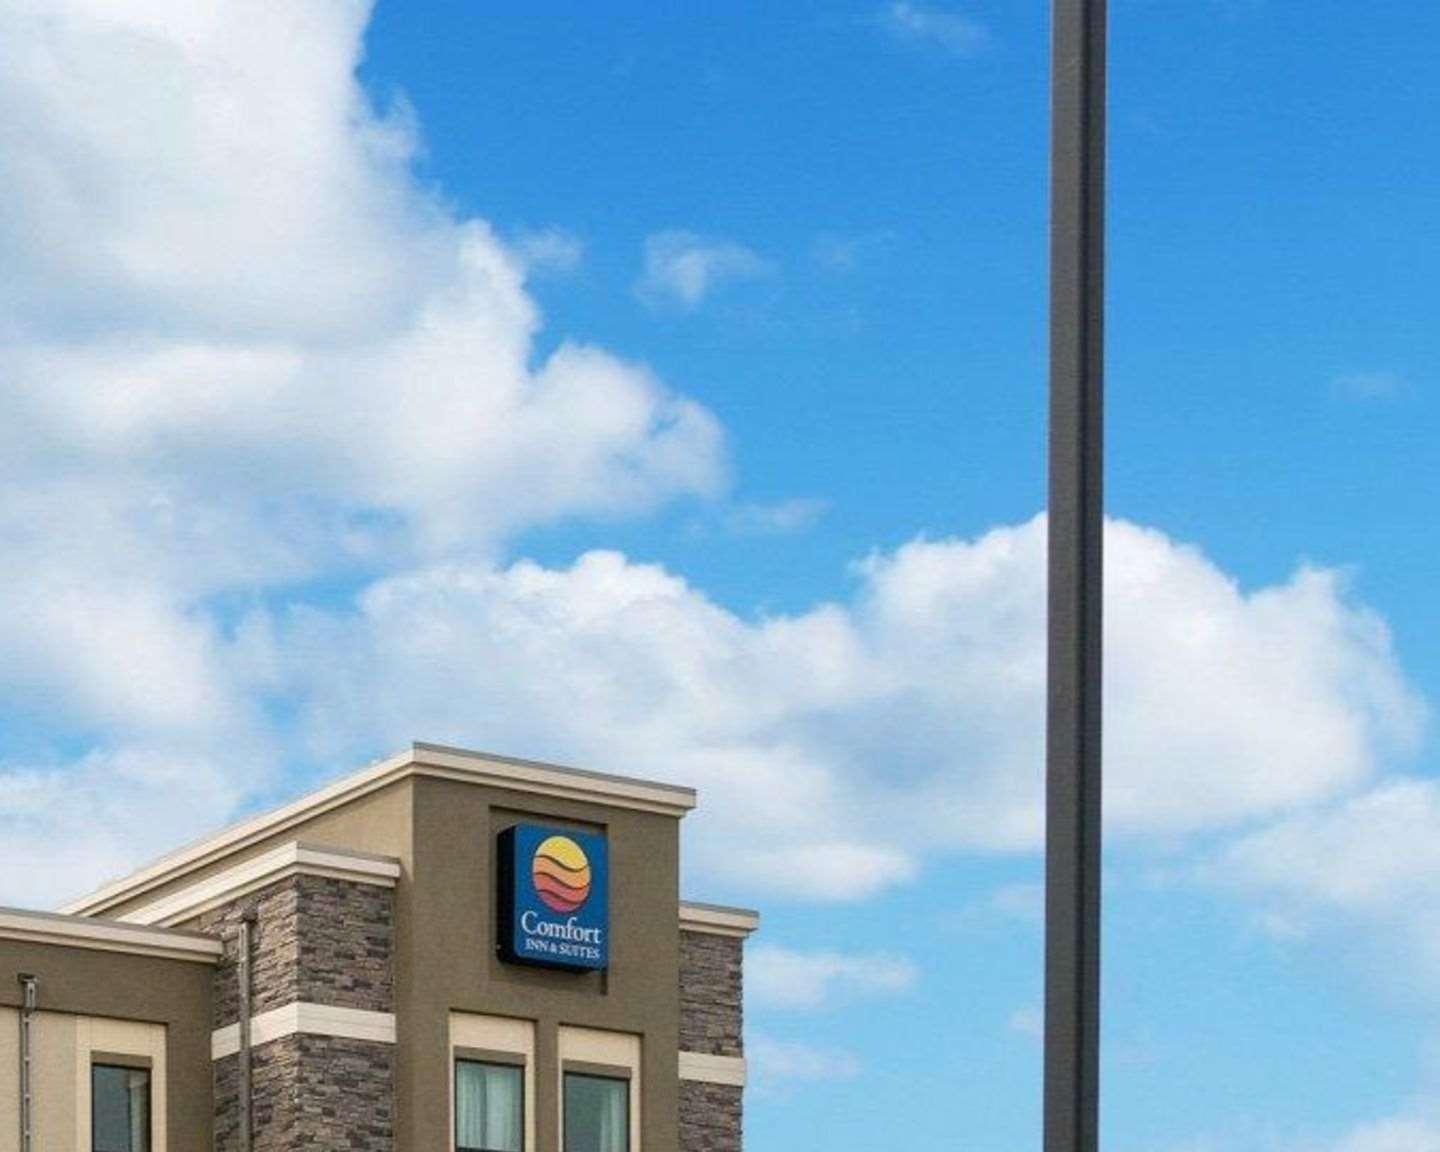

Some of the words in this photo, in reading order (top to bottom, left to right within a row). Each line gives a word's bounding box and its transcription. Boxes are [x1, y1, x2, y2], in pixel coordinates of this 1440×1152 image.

[521, 910, 601, 944] Comfort
[524, 938, 549, 952] INN
[559, 943, 601, 959] SUITES
